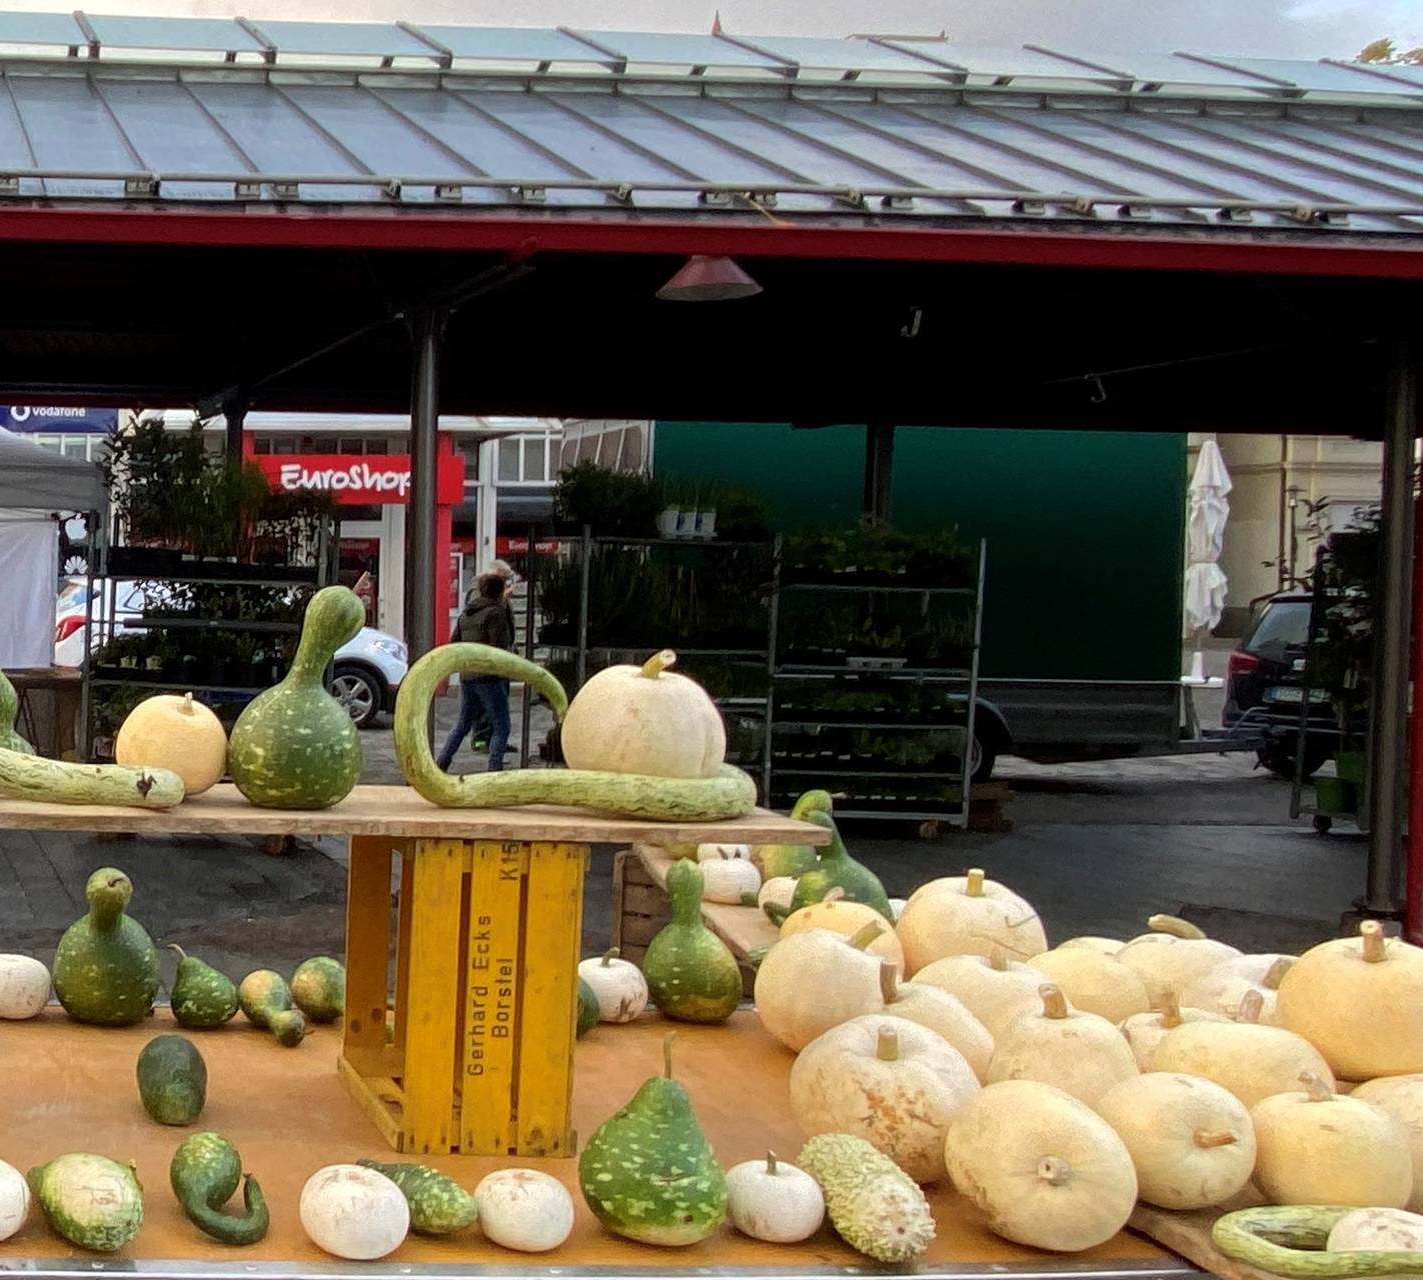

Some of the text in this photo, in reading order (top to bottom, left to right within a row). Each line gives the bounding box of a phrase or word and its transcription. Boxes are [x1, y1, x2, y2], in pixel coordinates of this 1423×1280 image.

[32, 406, 86, 416] vodafone
[280, 463, 411, 496] EuroShop
[499, 841, 520, 881] K15
[467, 915, 491, 1076] Gerhard Ecks
[491, 957, 514, 1039] Borstel
